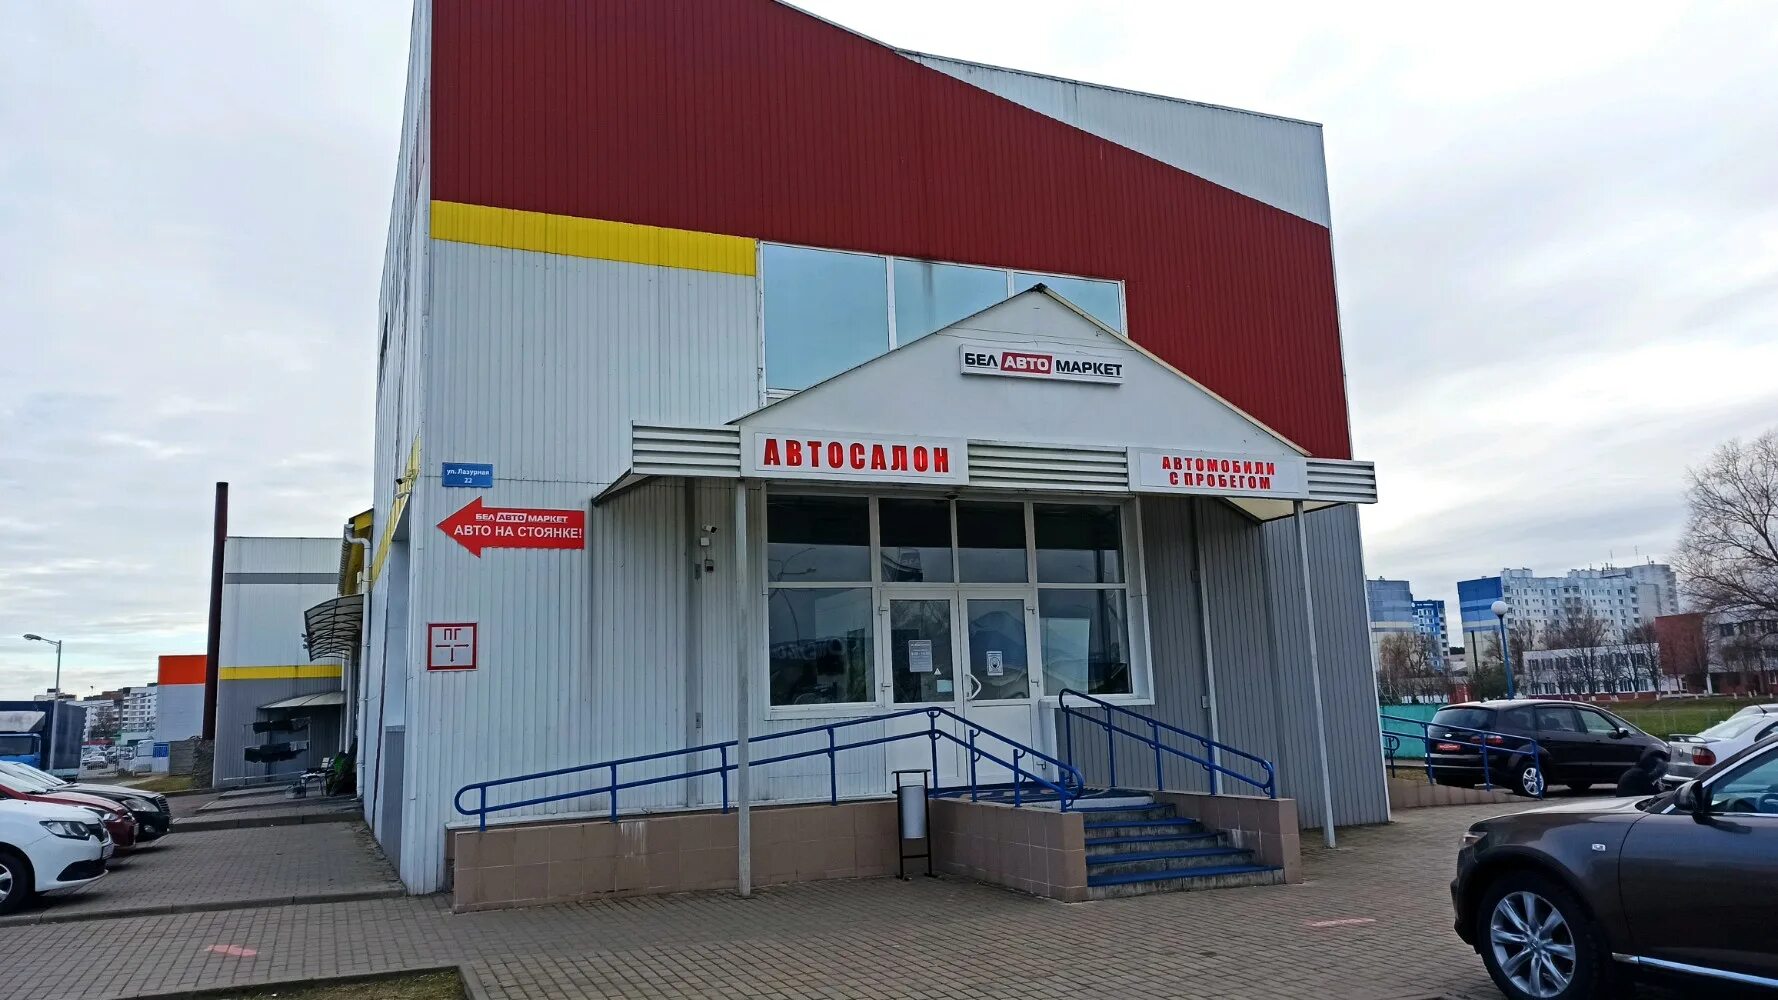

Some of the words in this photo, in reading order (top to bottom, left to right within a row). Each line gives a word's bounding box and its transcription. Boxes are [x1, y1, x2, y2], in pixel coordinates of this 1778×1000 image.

[964, 352, 998, 367] БЕЛ
[1004, 355, 1050, 371] АВТО
[1055, 359, 1123, 376] МАРКЕТ
[763, 438, 950, 473] АВТОСАЛОН
[457, 468, 490, 476] Лазурная
[1162, 456, 1275, 475] АВТОМОБИЛИ
[1169, 471, 1179, 486] С
[1183, 472, 1271, 489] ПРОБЕГОМ
[475, 513, 495, 521] БЕЛ
[498, 514, 525, 522] АВТО
[527, 514, 568, 523] МАРКЕТ
[453, 524, 491, 536] АВТО
[495, 525, 514, 537] НА
[517, 526, 582, 538] СТОЯНКЕ!
[443, 628, 462, 640] ПГ
